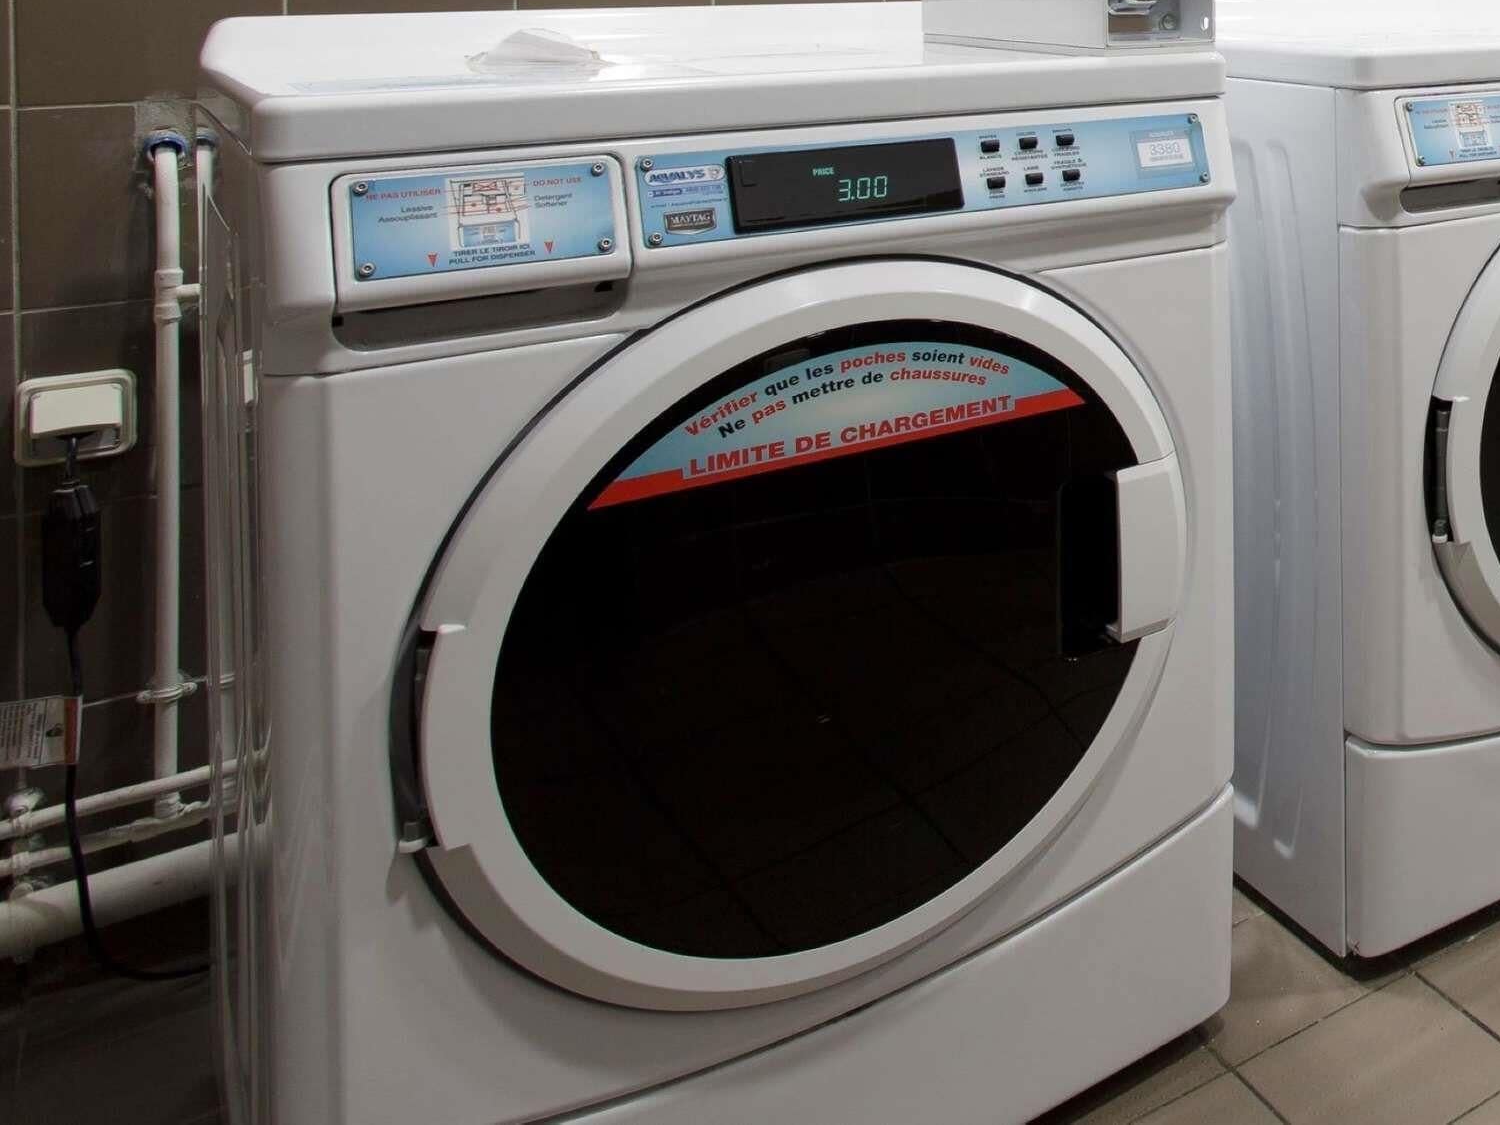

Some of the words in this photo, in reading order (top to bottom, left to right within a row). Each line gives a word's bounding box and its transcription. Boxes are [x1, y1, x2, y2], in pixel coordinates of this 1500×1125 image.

[812, 166, 835, 176] PRICE
[838, 175, 888, 202] 3.00
[671, 213, 711, 224] MAYTAG
[685, 391, 758, 436] Vérifier
[764, 375, 799, 396] que
[806, 363, 834, 380] les
[840, 351, 906, 373] poches
[912, 349, 966, 364] soient
[969, 355, 1009, 375] vides
[717, 418, 746, 438] Ne
[752, 399, 787, 424] pas
[792, 377, 855, 405] mettre
[861, 371, 884, 385] de
[890, 368, 986, 386] chaussures
[690, 441, 785, 475] LIMITE
[795, 431, 832, 453] DE
[840, 395, 1011, 444] CHARGEMENT
